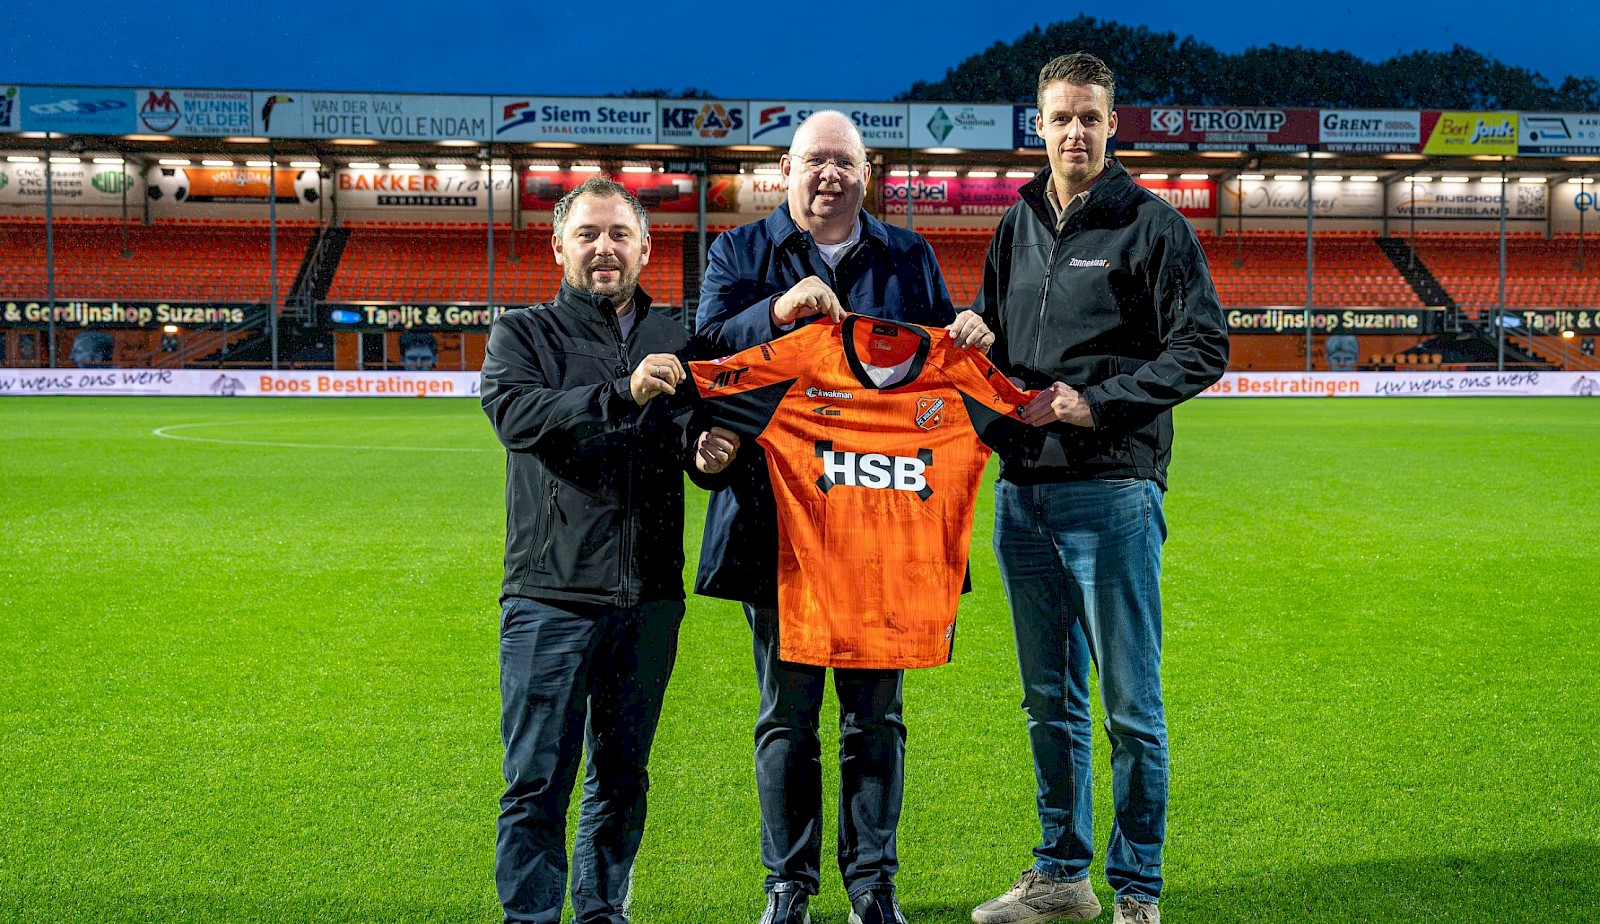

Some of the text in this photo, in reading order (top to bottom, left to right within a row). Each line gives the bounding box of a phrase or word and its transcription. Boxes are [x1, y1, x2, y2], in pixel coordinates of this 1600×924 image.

[184, 101, 248, 112] MUNNIK
[313, 99, 403, 114] VAN DER VALK
[541, 106, 651, 123] Siem Steur
[185, 113, 249, 126] VELDER
[313, 115, 485, 136] HOTEL VOLENDAM
[662, 108, 744, 130] KRAS
[851, 111, 903, 127] Steur
[1188, 110, 1286, 132] TROMP
[1323, 114, 1382, 130] GRENT
[1441, 118, 1469, 135] Bert
[541, 126, 652, 135] STAALCONSTRUCTIES
[16, 168, 40, 177] CNC
[19, 179, 43, 187] CNC
[339, 174, 438, 191] BAKKER
[4, 302, 244, 327] & Gordijnshop Suzanne
[364, 306, 422, 329] Tapijt
[426, 306, 441, 324] &
[1227, 310, 1419, 332] Gordijnshop Suzanne
[1522, 311, 1575, 332] Tapijt
[1577, 311, 1591, 329] &
[0, 369, 173, 390] w wens ons werk
[259, 375, 312, 393] Boos
[317, 376, 454, 397] Bestratingen
[1237, 377, 1360, 397] Bestratingen
[1409, 376, 1453, 392] wens
[1459, 374, 1491, 388] ons
[1497, 370, 1540, 386] werk
[818, 388, 853, 399] kwakman
[823, 450, 927, 492] HSB
